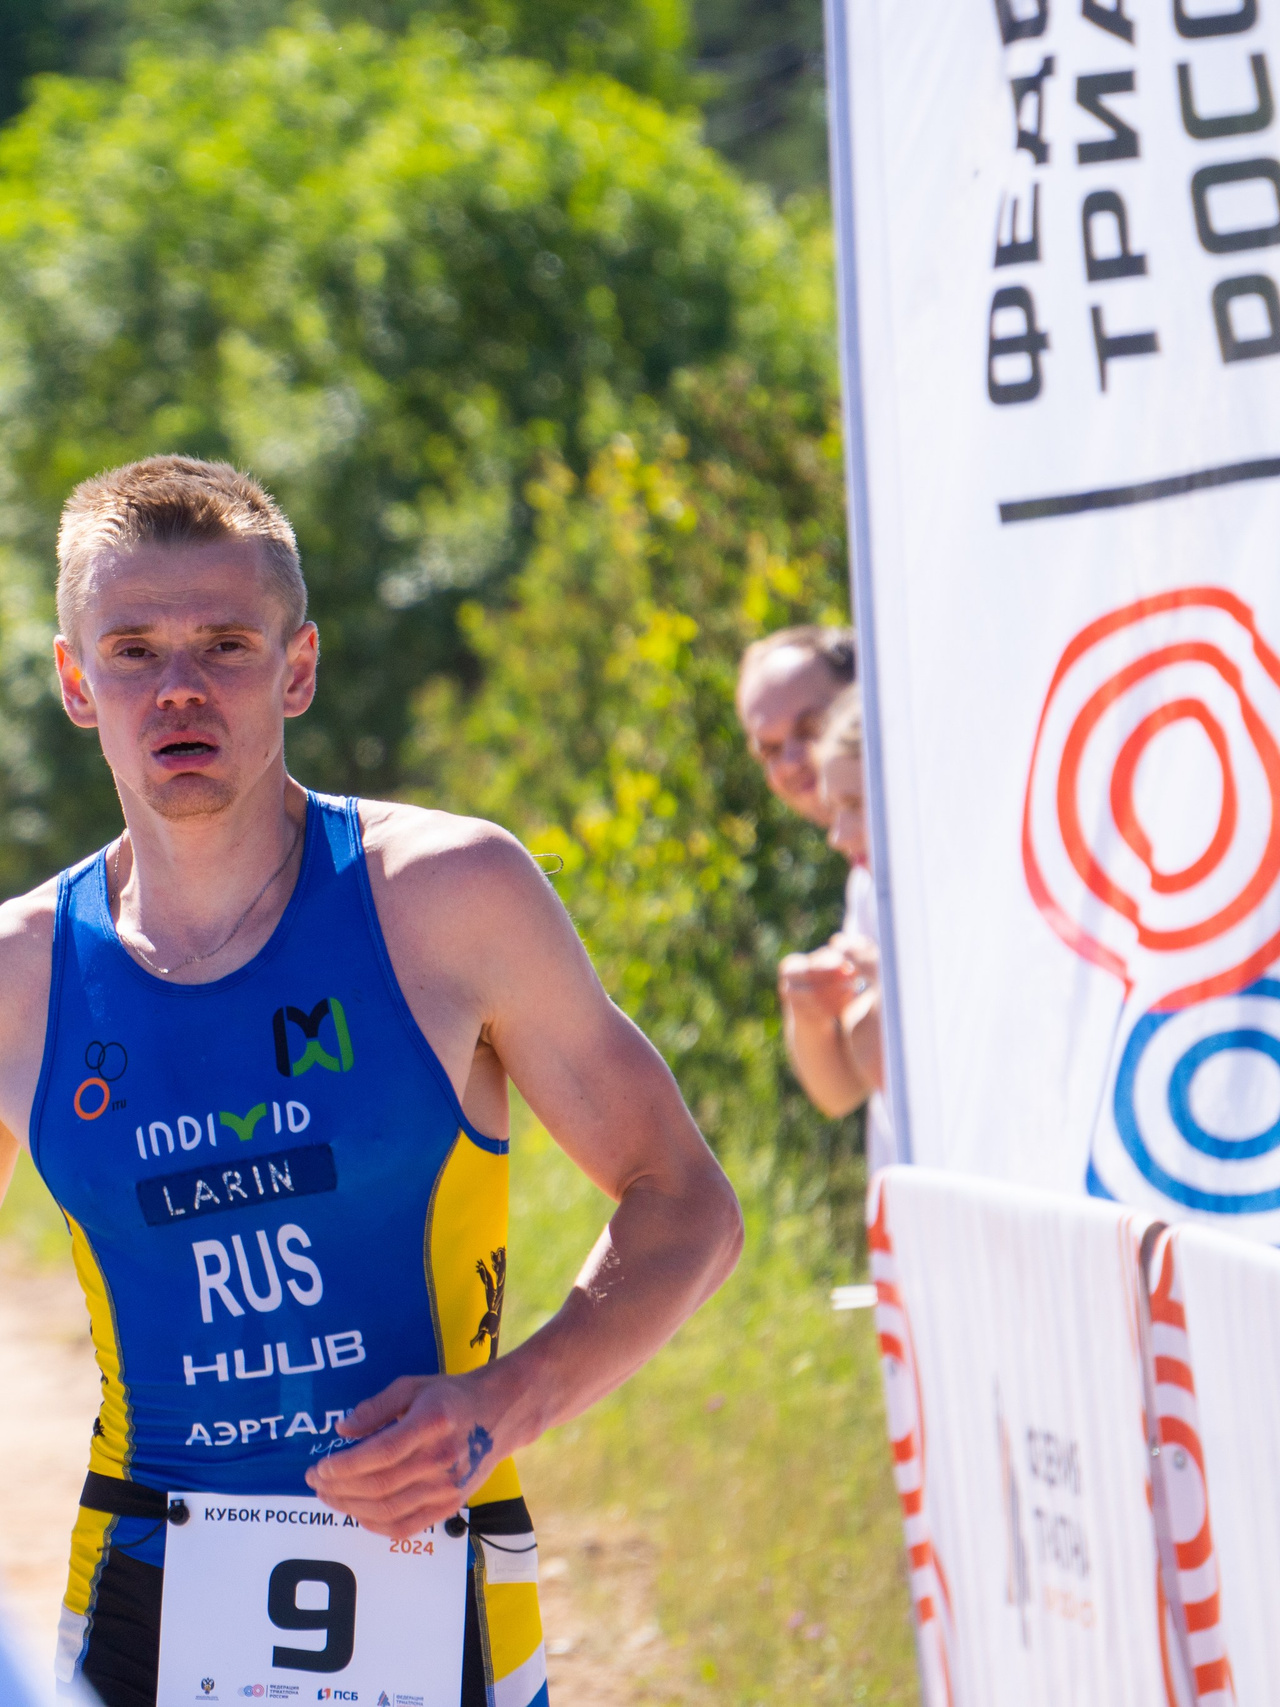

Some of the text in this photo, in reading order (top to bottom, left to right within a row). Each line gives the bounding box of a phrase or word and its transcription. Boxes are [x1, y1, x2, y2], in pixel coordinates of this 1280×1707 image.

[111, 1098, 127, 1111] ITU
[135, 1100, 311, 1160] INDIVID
[162, 1159, 295, 1216] LARIN
[192, 1223, 323, 1324] RUS
[183, 1330, 366, 1386] HUUB
[205, 1507, 261, 1523] КУБОК
[265, 1510, 339, 1527] РОССИИ.
[389, 1538, 435, 1556] 2024
[267, 1558, 358, 1674] 9
[333, 1690, 359, 1701] ПСБ
